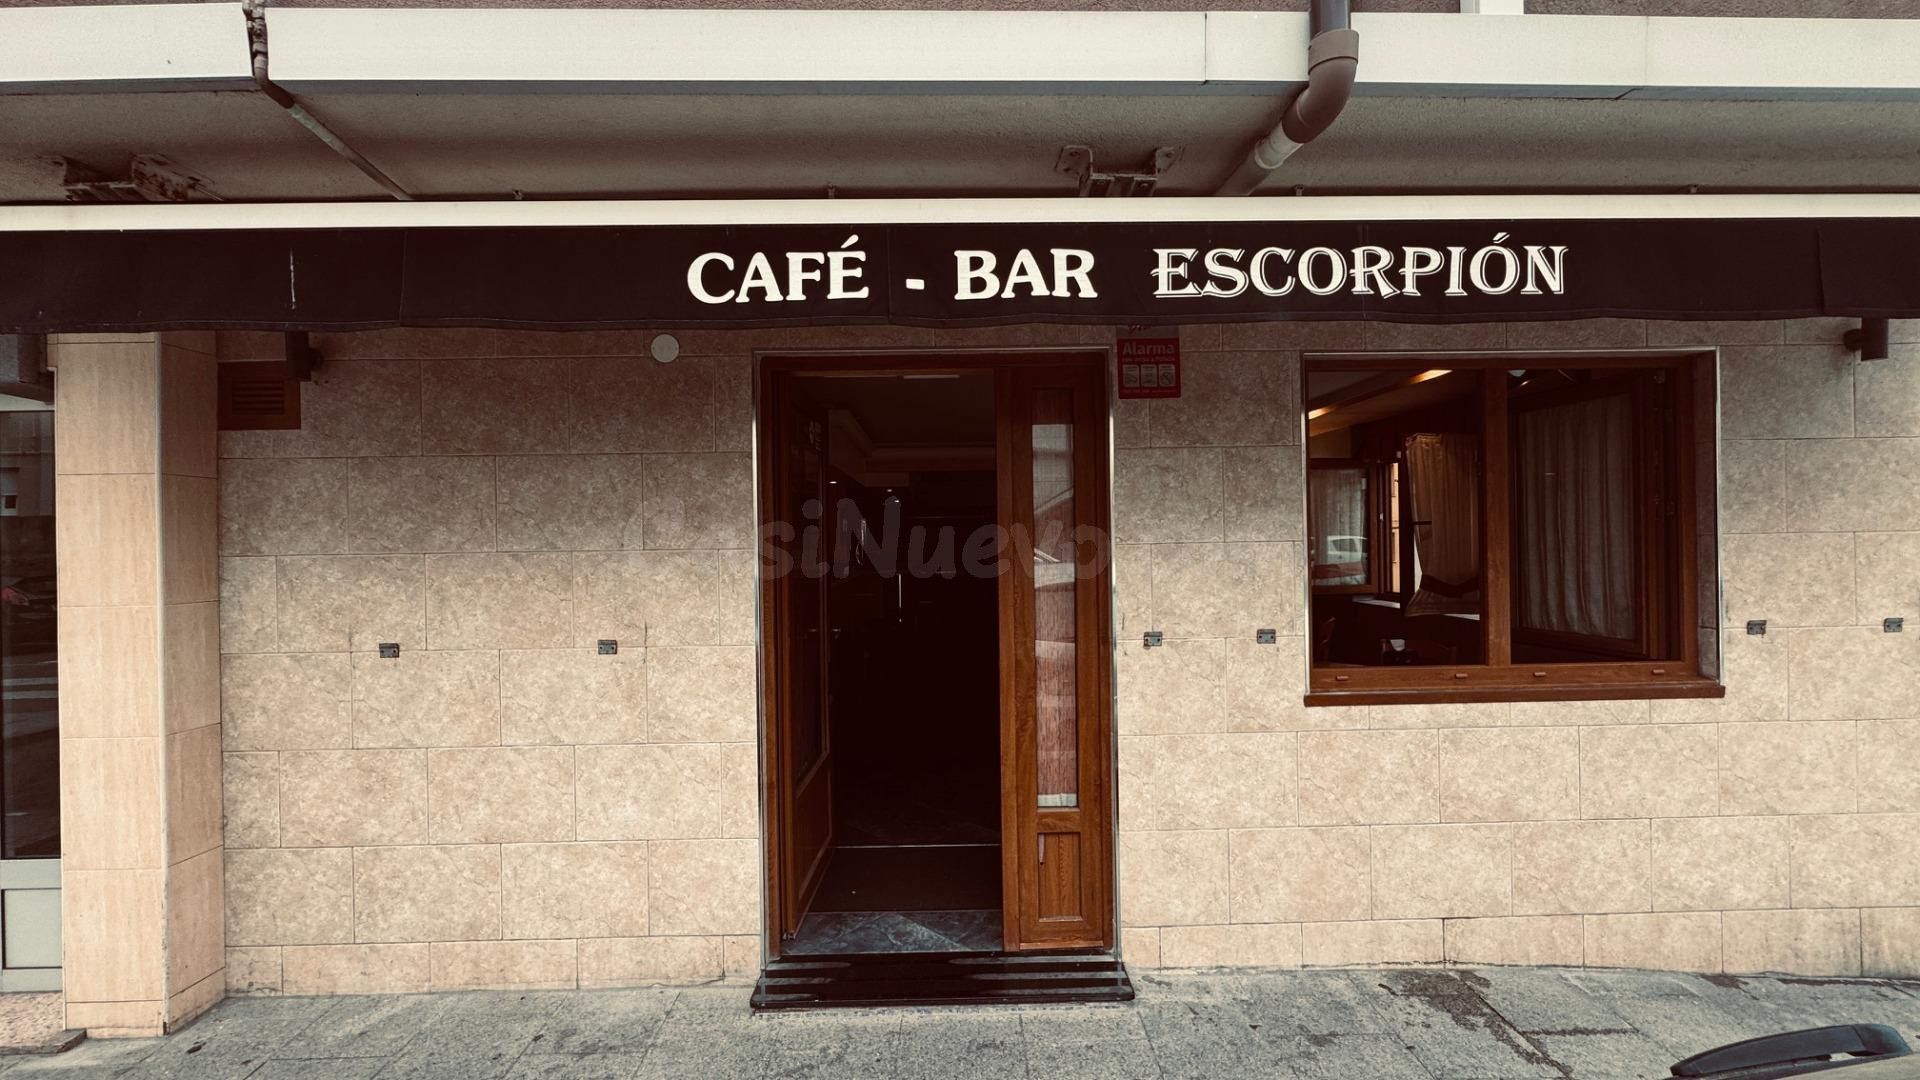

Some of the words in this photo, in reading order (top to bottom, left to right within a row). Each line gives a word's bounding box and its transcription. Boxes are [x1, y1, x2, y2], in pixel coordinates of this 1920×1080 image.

[687, 234, 869, 304] CAFÉ
[953, 248, 1099, 300] BAR
[1150, 231, 1569, 299] ESCORPIÓN
[1122, 340, 1176, 355] Alarma
